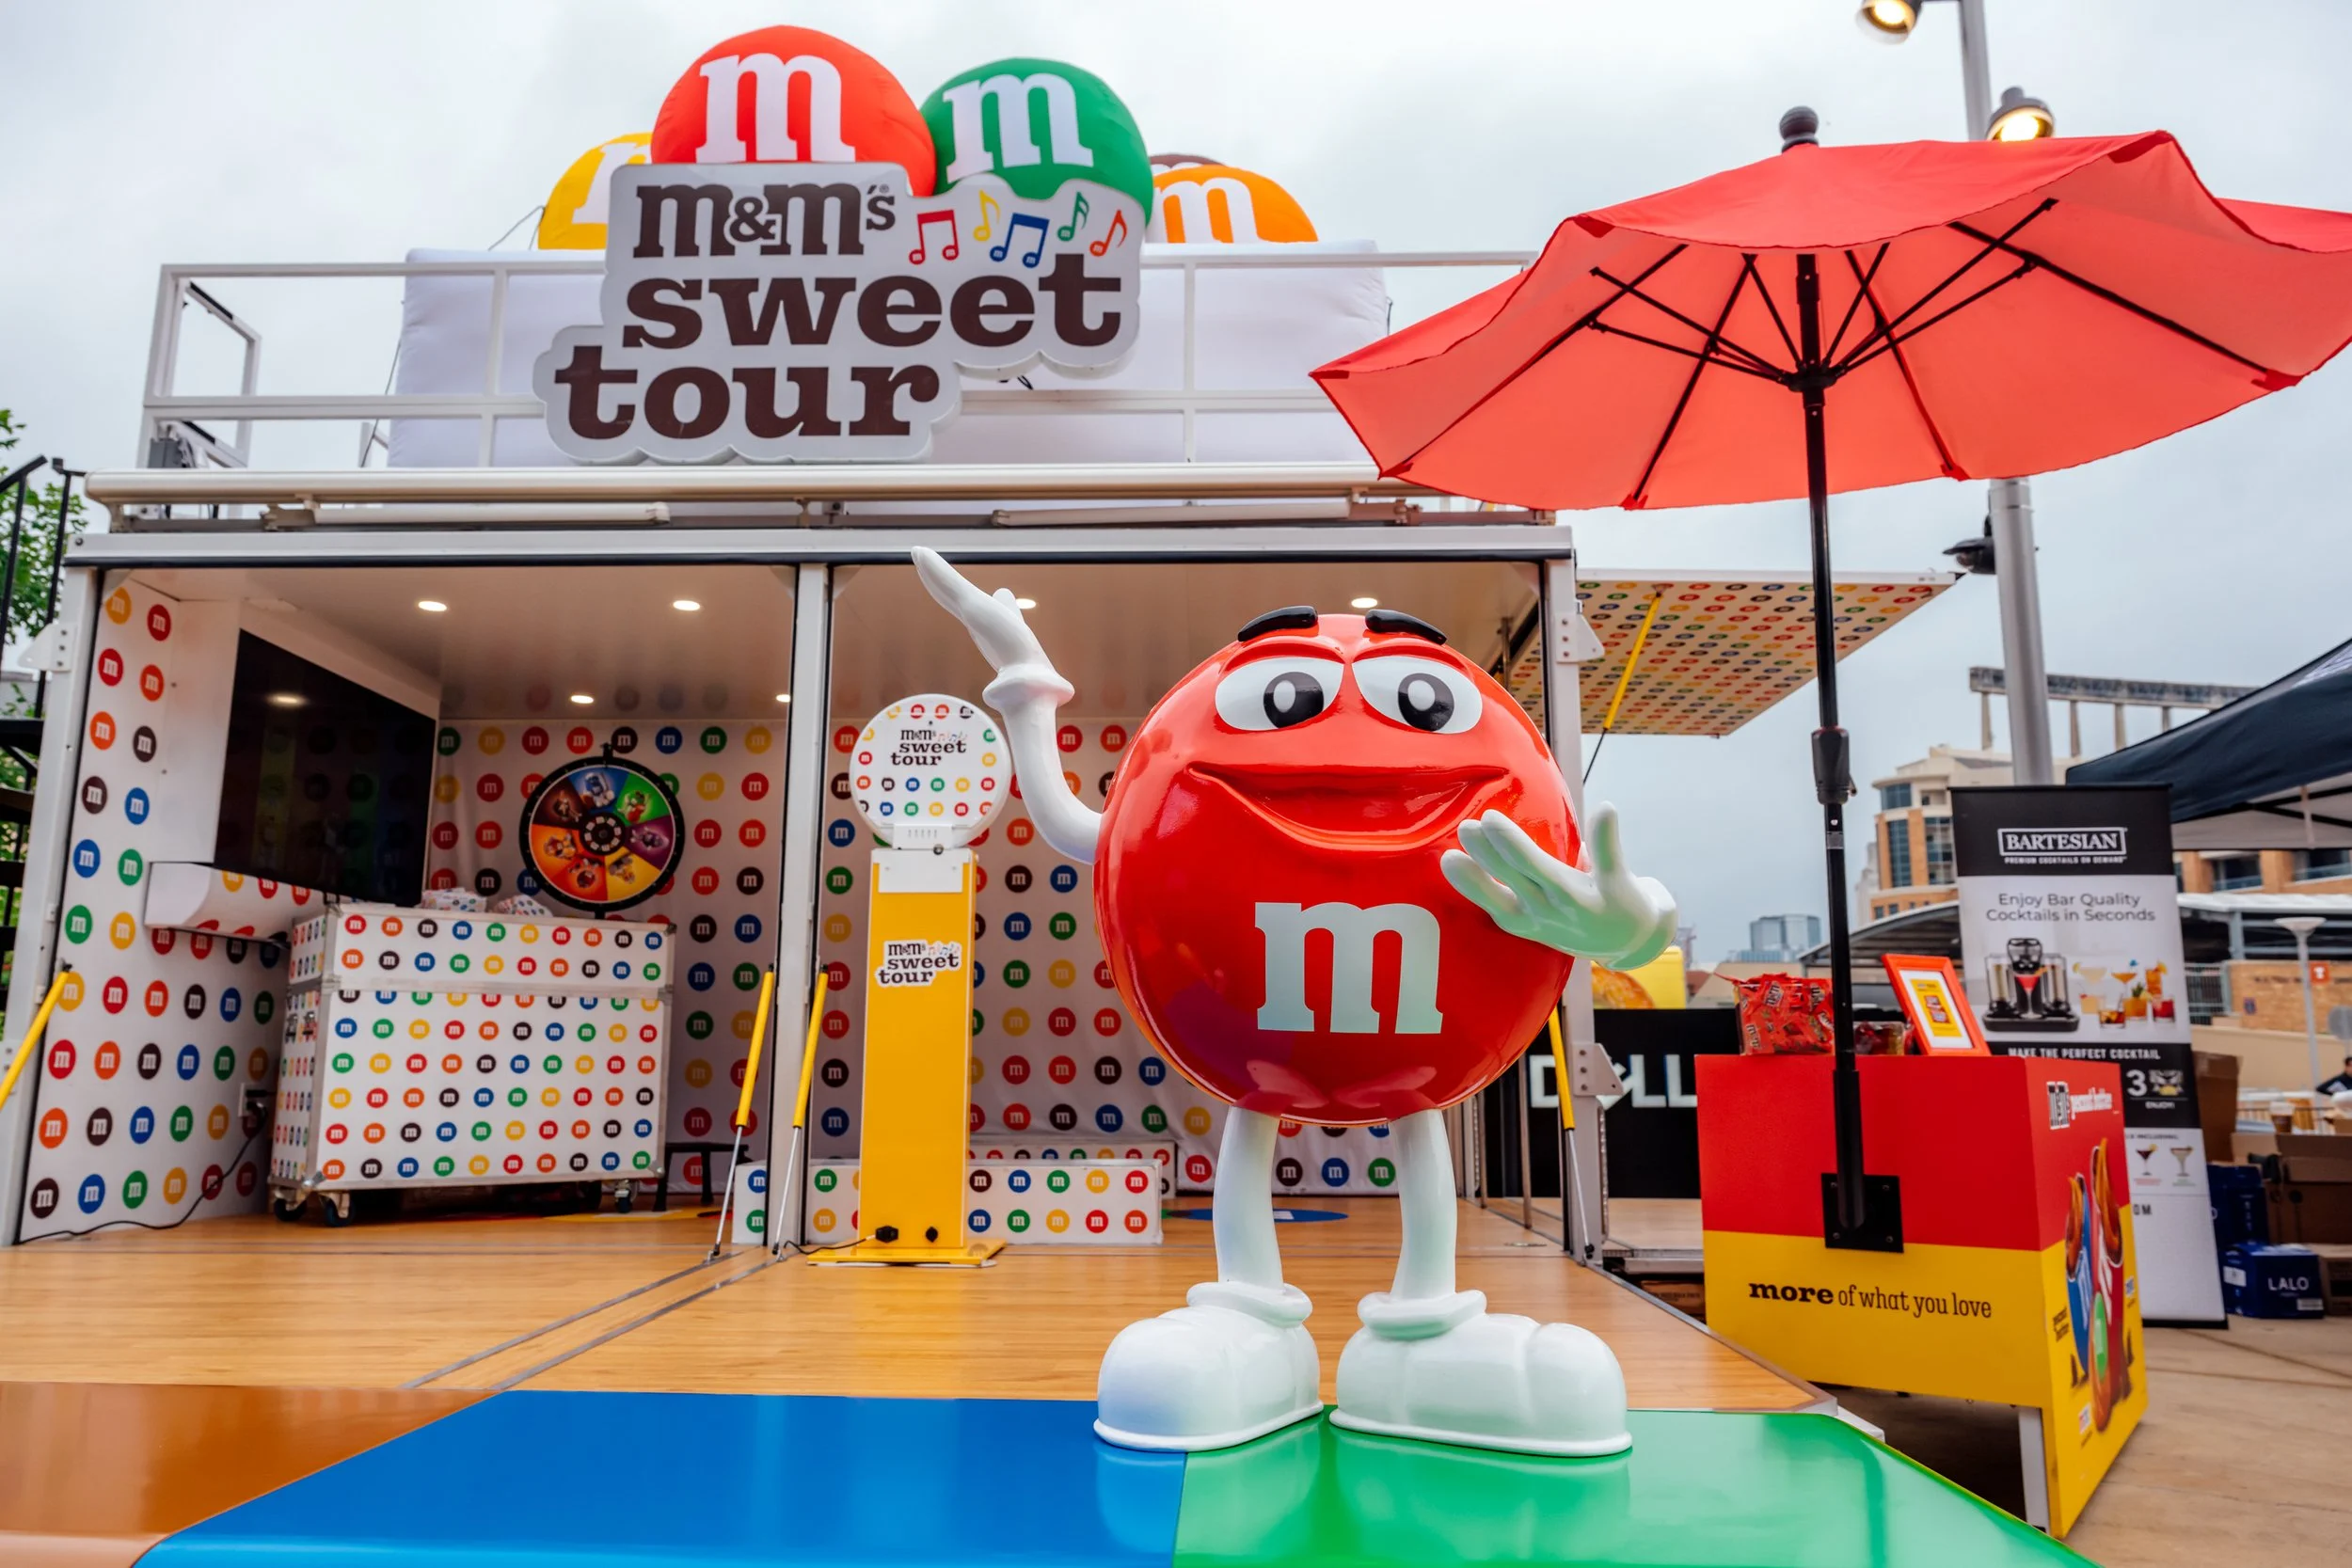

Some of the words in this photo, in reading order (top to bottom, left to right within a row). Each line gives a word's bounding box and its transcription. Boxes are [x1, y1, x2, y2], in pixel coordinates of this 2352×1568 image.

[696, 53, 856, 163] m
[943, 72, 1093, 184] m
[622, 253, 1121, 349] sweet
[555, 344, 939, 439] tour
[103, 657, 118, 677] m
[145, 674, 159, 692] m
[95, 721, 110, 740] m
[137, 735, 151, 753] m
[617, 735, 631, 746] m
[662, 735, 675, 746] m
[1061, 734, 1075, 745] m
[899, 740, 966, 753] sweet
[890, 752, 942, 766] tour
[749, 781, 762, 792] m
[87, 785, 103, 805] m
[130, 798, 144, 815] m
[702, 828, 714, 839] m
[834, 827, 849, 839] m
[1013, 826, 1027, 838] m
[2006, 833, 2118, 850] BARTESIAN
[79, 849, 94, 867] m
[123, 859, 137, 876] m
[481, 877, 495, 888] m
[743, 875, 757, 887] m
[833, 875, 847, 886] m
[1011, 873, 1025, 885] m
[1057, 873, 1071, 885] m
[1998, 894, 2042, 908] Enjoy
[2047, 894, 2075, 906] Bar
[2080, 894, 2140, 908] Quality
[1986, 909, 2060, 921] Cocktails
[2064, 909, 2079, 921] in
[2084, 909, 2155, 922] Seconds
[71, 916, 87, 933] m
[116, 922, 130, 939] m
[456, 926, 468, 935] m
[696, 923, 709, 935] m
[741, 923, 755, 934] m
[1010, 921, 1025, 932] m
[1056, 920, 1070, 932] m
[383, 956, 395, 965] m
[419, 958, 430, 966] m
[454, 958, 466, 968] m
[887, 953, 959, 970] sweet
[585, 964, 596, 974] m
[616, 966, 627, 974] m
[1009, 968, 1024, 980] m
[1255, 902, 1443, 1034] m
[739, 971, 754, 983] m
[830, 971, 843, 982] m
[878, 970, 932, 984] tour
[107, 987, 122, 1004] m
[150, 990, 163, 1006] m
[188, 994, 201, 1009] m
[225, 998, 236, 1011] m
[1056, 1016, 1069, 1027] m
[1101, 1016, 1115, 1028] m
[340, 1023, 352, 1033] m
[377, 1024, 389, 1034] m
[516, 1026, 528, 1036] m
[549, 1027, 560, 1037] m
[54, 1051, 71, 1069] m
[2008, 1048, 2037, 1057] MAKE
[2040, 1048, 2058, 1058] THE
[2062, 1049, 2106, 1059] PERFECT
[2110, 1049, 2161, 1060] COCKTAIL
[100, 1053, 115, 1069] m
[142, 1053, 156, 1069] m
[182, 1055, 195, 1069] m
[337, 1058, 349, 1068] m
[481, 1059, 492, 1069] m
[515, 1060, 525, 1069] m
[548, 1060, 558, 1069] m
[828, 1068, 842, 1079] m
[1009, 1065, 1023, 1076] m
[1101, 1065, 1115, 1076] m
[1145, 1066, 1159, 1077] m
[2126, 1069, 2148, 1097] 3
[443, 1093, 455, 1102] m
[478, 1093, 489, 1101] m
[512, 1093, 523, 1101] m
[640, 1092, 650, 1101] m
[828, 1117, 842, 1128] m
[1010, 1112, 1024, 1123] m
[1056, 1112, 1071, 1124] m
[1103, 1113, 1116, 1125] m
[1148, 1113, 1162, 1125] m
[45, 1120, 61, 1137] m
[91, 1118, 107, 1135] m
[135, 1117, 149, 1133] m
[175, 1117, 188, 1132] m
[607, 1124, 617, 1133] m
[638, 1124, 648, 1132] m
[369, 1129, 380, 1138] m
[405, 1128, 417, 1137] m
[440, 1128, 453, 1136] m
[476, 1127, 487, 1136] m
[327, 1165, 340, 1175] m
[365, 1164, 377, 1174] m
[403, 1163, 414, 1172] m
[438, 1162, 450, 1171] m
[1192, 1164, 1205, 1175] m
[1282, 1166, 1296, 1179] m
[1328, 1166, 1343, 1179] m
[1375, 1166, 1389, 1179] m
[168, 1179, 181, 1194] m
[819, 1176, 832, 1186] m
[974, 1176, 987, 1186] m
[1013, 1177, 1025, 1186] m
[1052, 1177, 1065, 1187] m
[1091, 1177, 1104, 1186] m
[1131, 1177, 1143, 1187] m
[84, 1186, 99, 1202] m
[128, 1181, 142, 1198] m
[36, 1189, 54, 1208] m
[818, 1215, 831, 1226] m
[973, 1215, 986, 1227] m
[1012, 1216, 1025, 1227] m
[1052, 1216, 1064, 1227] m
[1091, 1216, 1104, 1227] m
[1130, 1216, 1142, 1227] m
[2267, 1276, 2310, 1291] LALO
[1749, 1283, 1834, 1305] more
[1838, 1285, 1857, 1306] of
[1858, 1287, 1910, 1311] what
[1913, 1294, 1948, 1318] you
[1952, 1292, 1992, 1318] love
